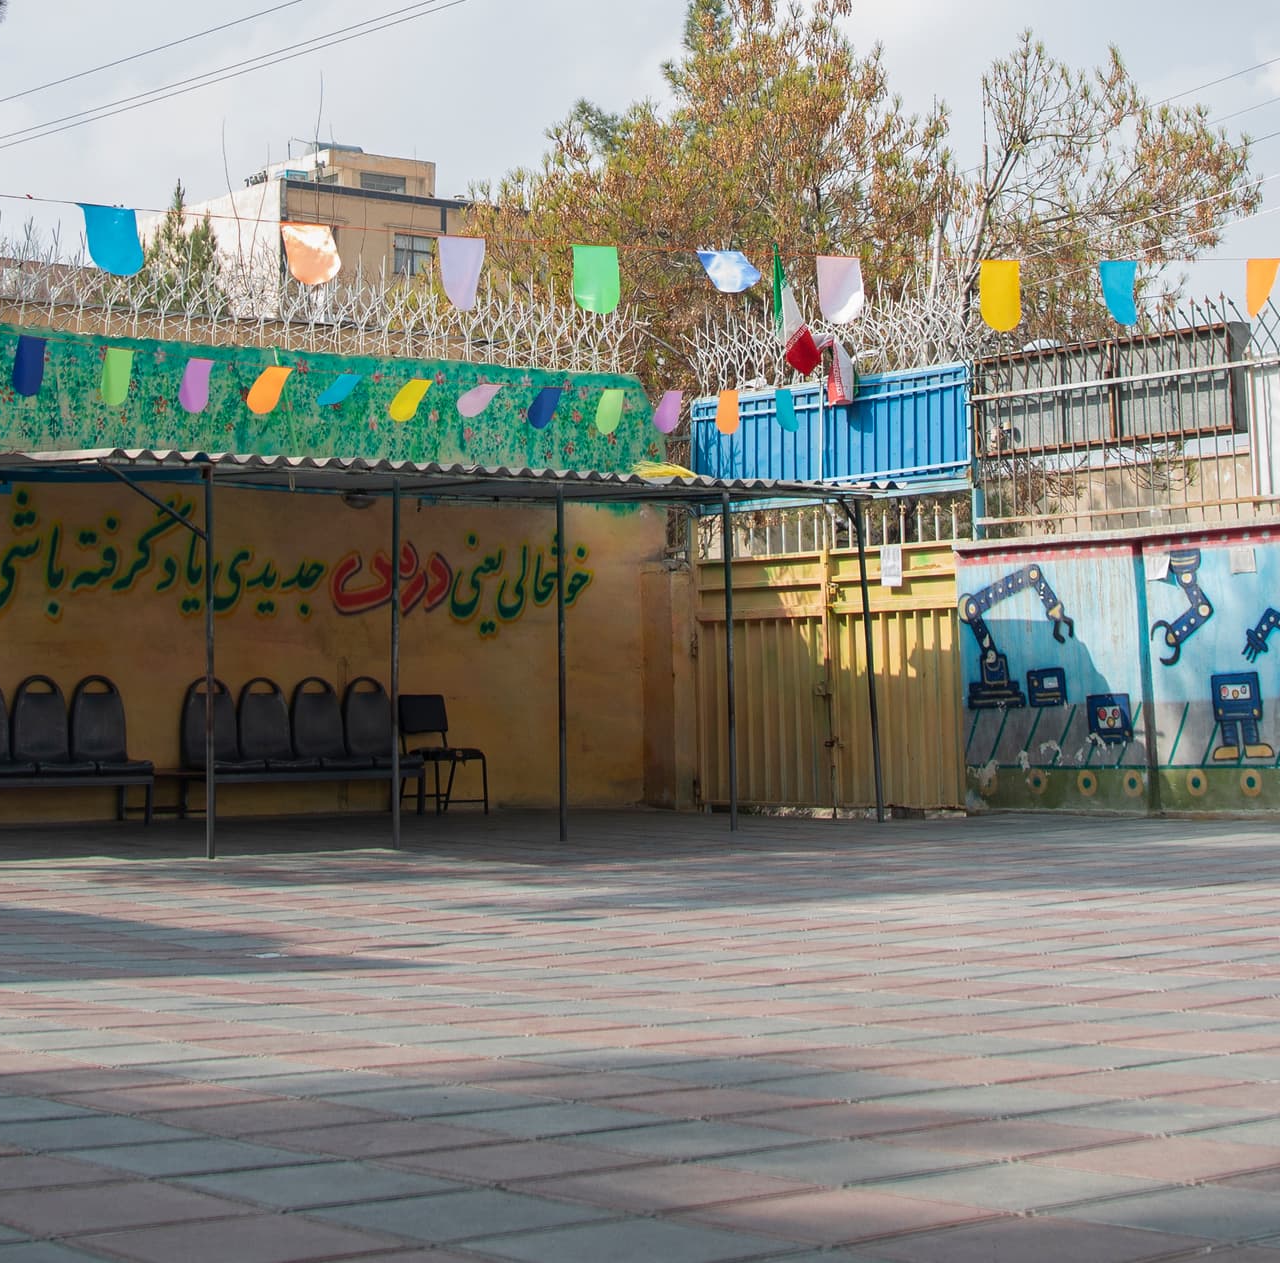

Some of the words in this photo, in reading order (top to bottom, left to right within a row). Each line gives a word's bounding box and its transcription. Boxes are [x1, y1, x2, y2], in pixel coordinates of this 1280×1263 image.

[72, 500, 192, 590] گرفته
[156, 532, 203, 614] یاد
[207, 549, 325, 616] جدیدی
[332, 540, 454, 619] درس
[450, 534, 504, 635] یعنی
